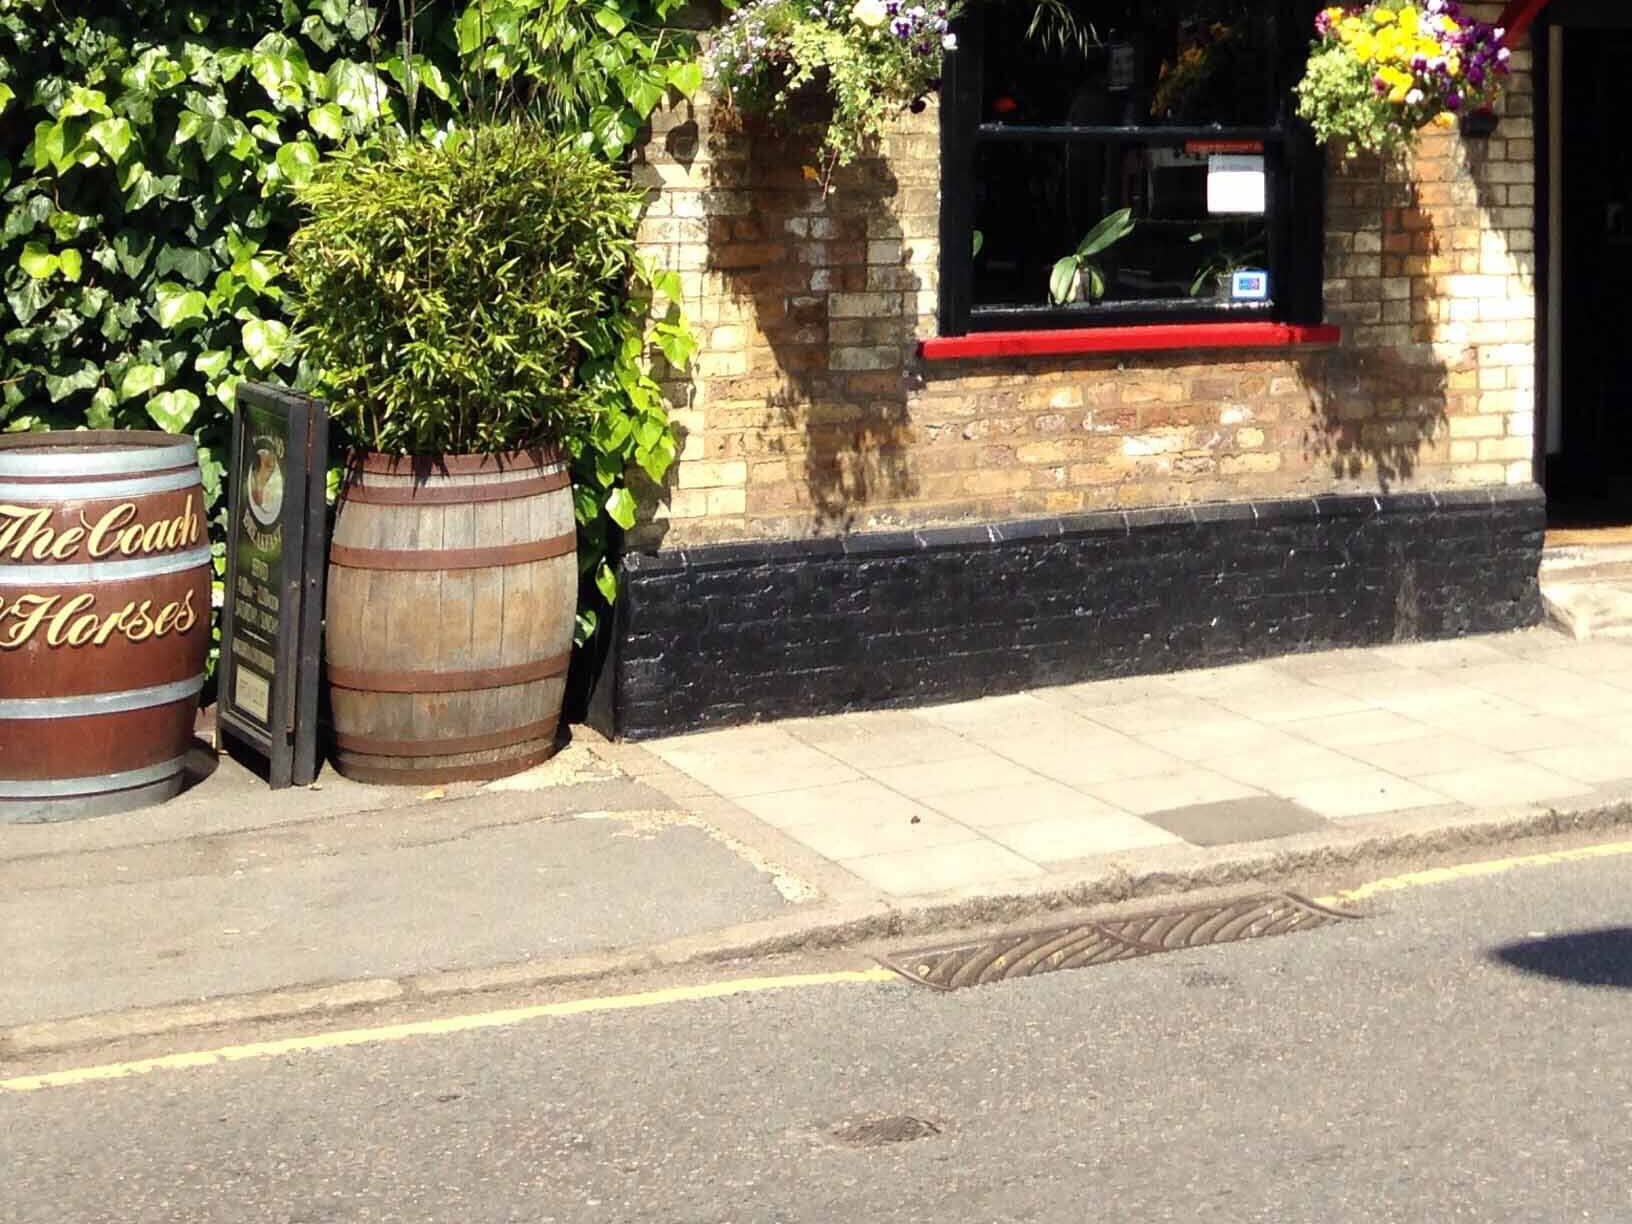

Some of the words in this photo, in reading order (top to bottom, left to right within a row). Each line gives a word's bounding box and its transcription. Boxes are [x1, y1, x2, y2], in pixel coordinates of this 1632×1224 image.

[0, 504, 86, 561] The
[80, 493, 200, 559] Coach
[2, 589, 197, 650] Horses
